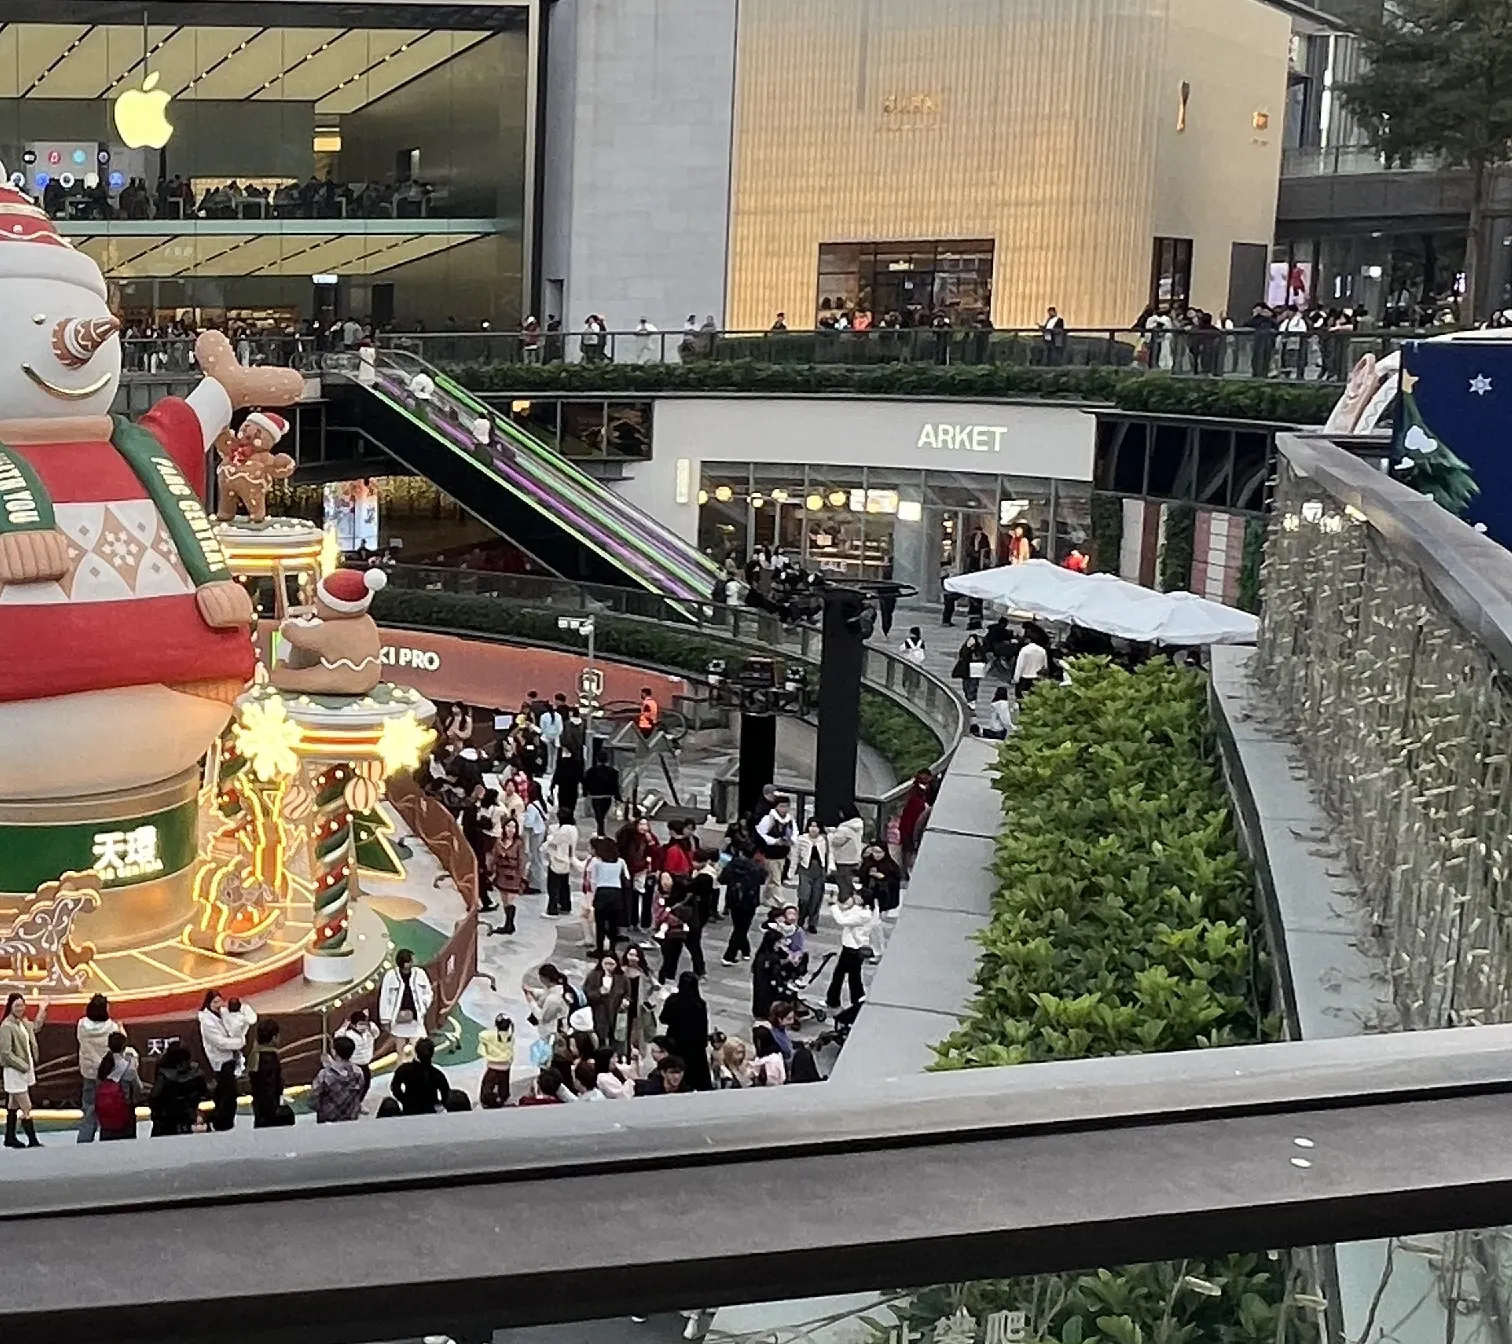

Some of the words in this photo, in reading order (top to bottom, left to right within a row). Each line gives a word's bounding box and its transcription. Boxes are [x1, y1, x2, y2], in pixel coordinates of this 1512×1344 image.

[917, 423, 1008, 452] ARKET
[2, 490, 41, 524] YOU
[178, 500, 225, 573] CENTRAL
[398, 647, 441, 672] PRO
